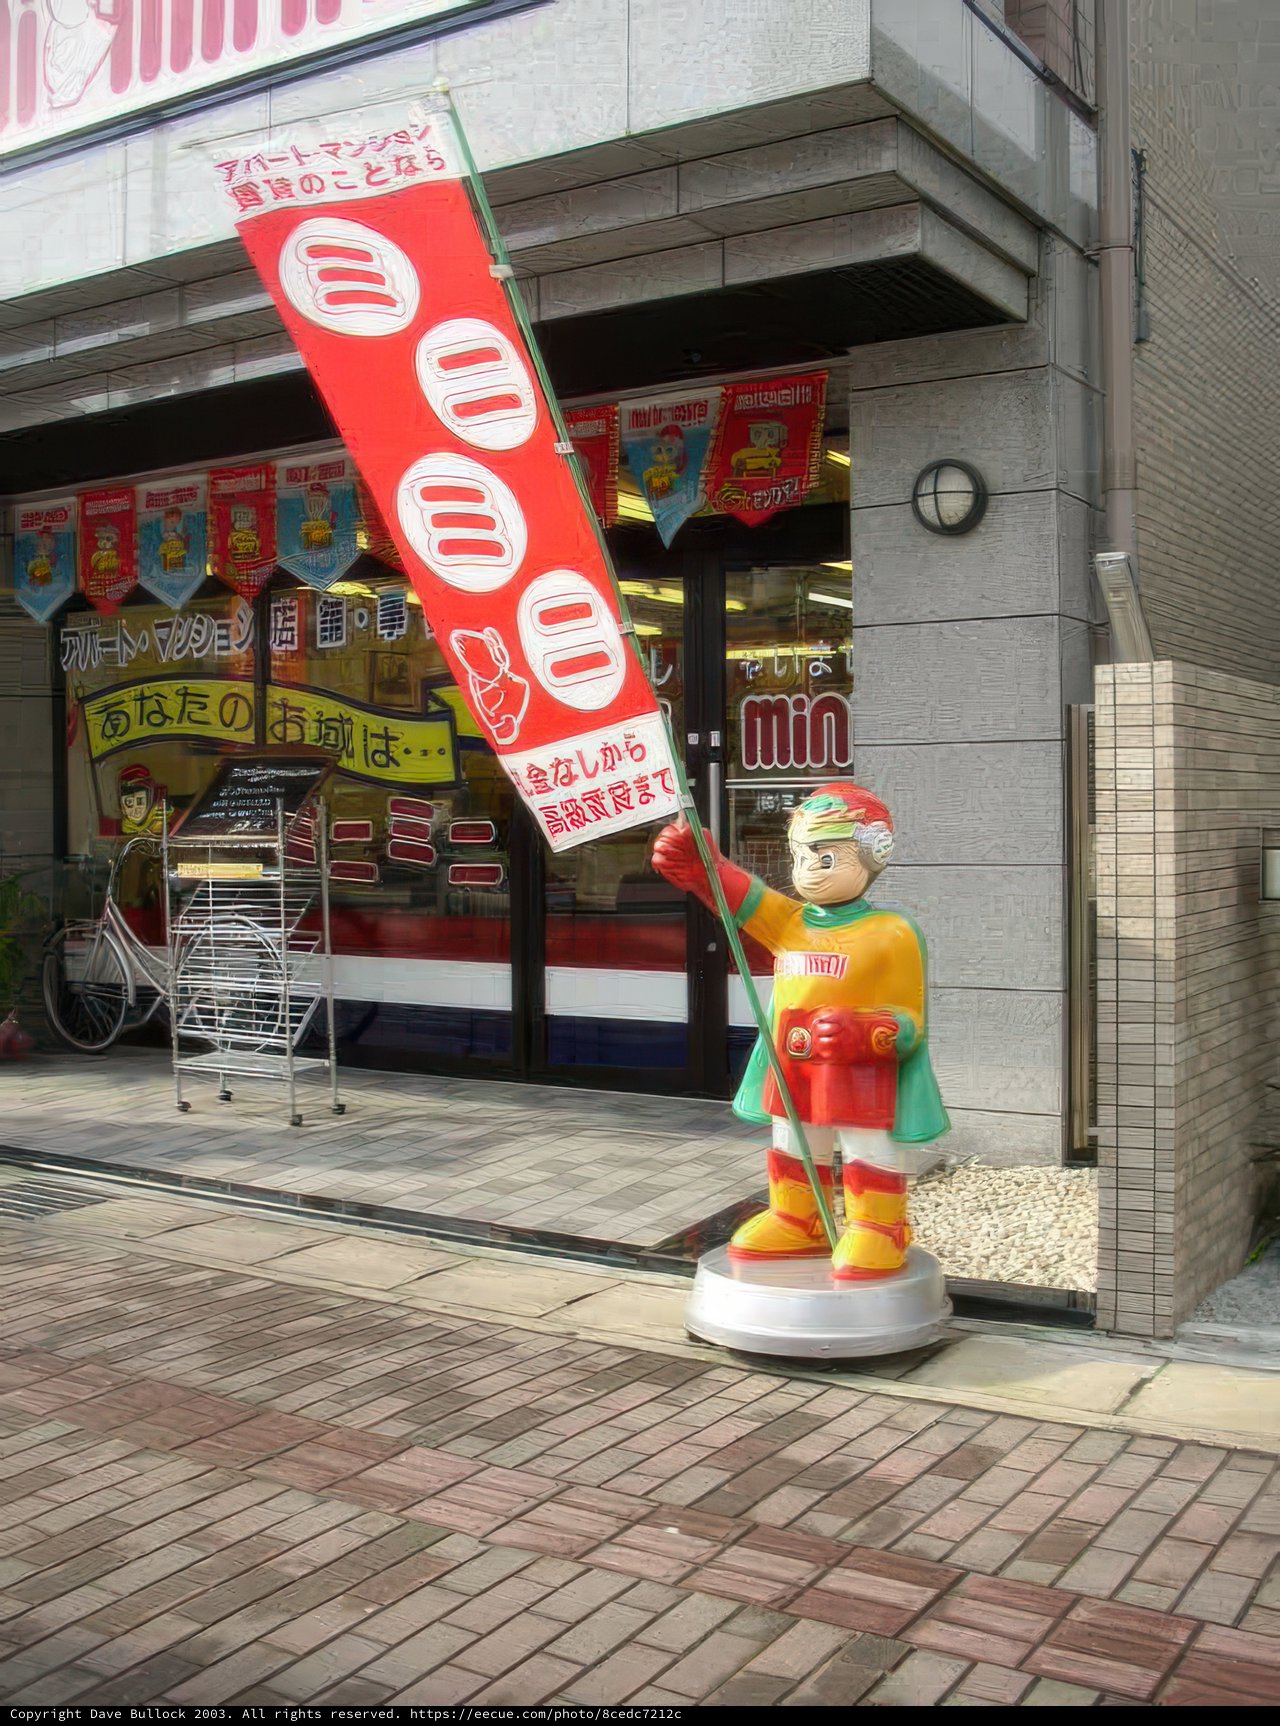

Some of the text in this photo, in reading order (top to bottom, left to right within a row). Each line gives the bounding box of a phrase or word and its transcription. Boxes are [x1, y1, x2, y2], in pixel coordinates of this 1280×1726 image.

[511, 732, 648, 799] 金なしから
